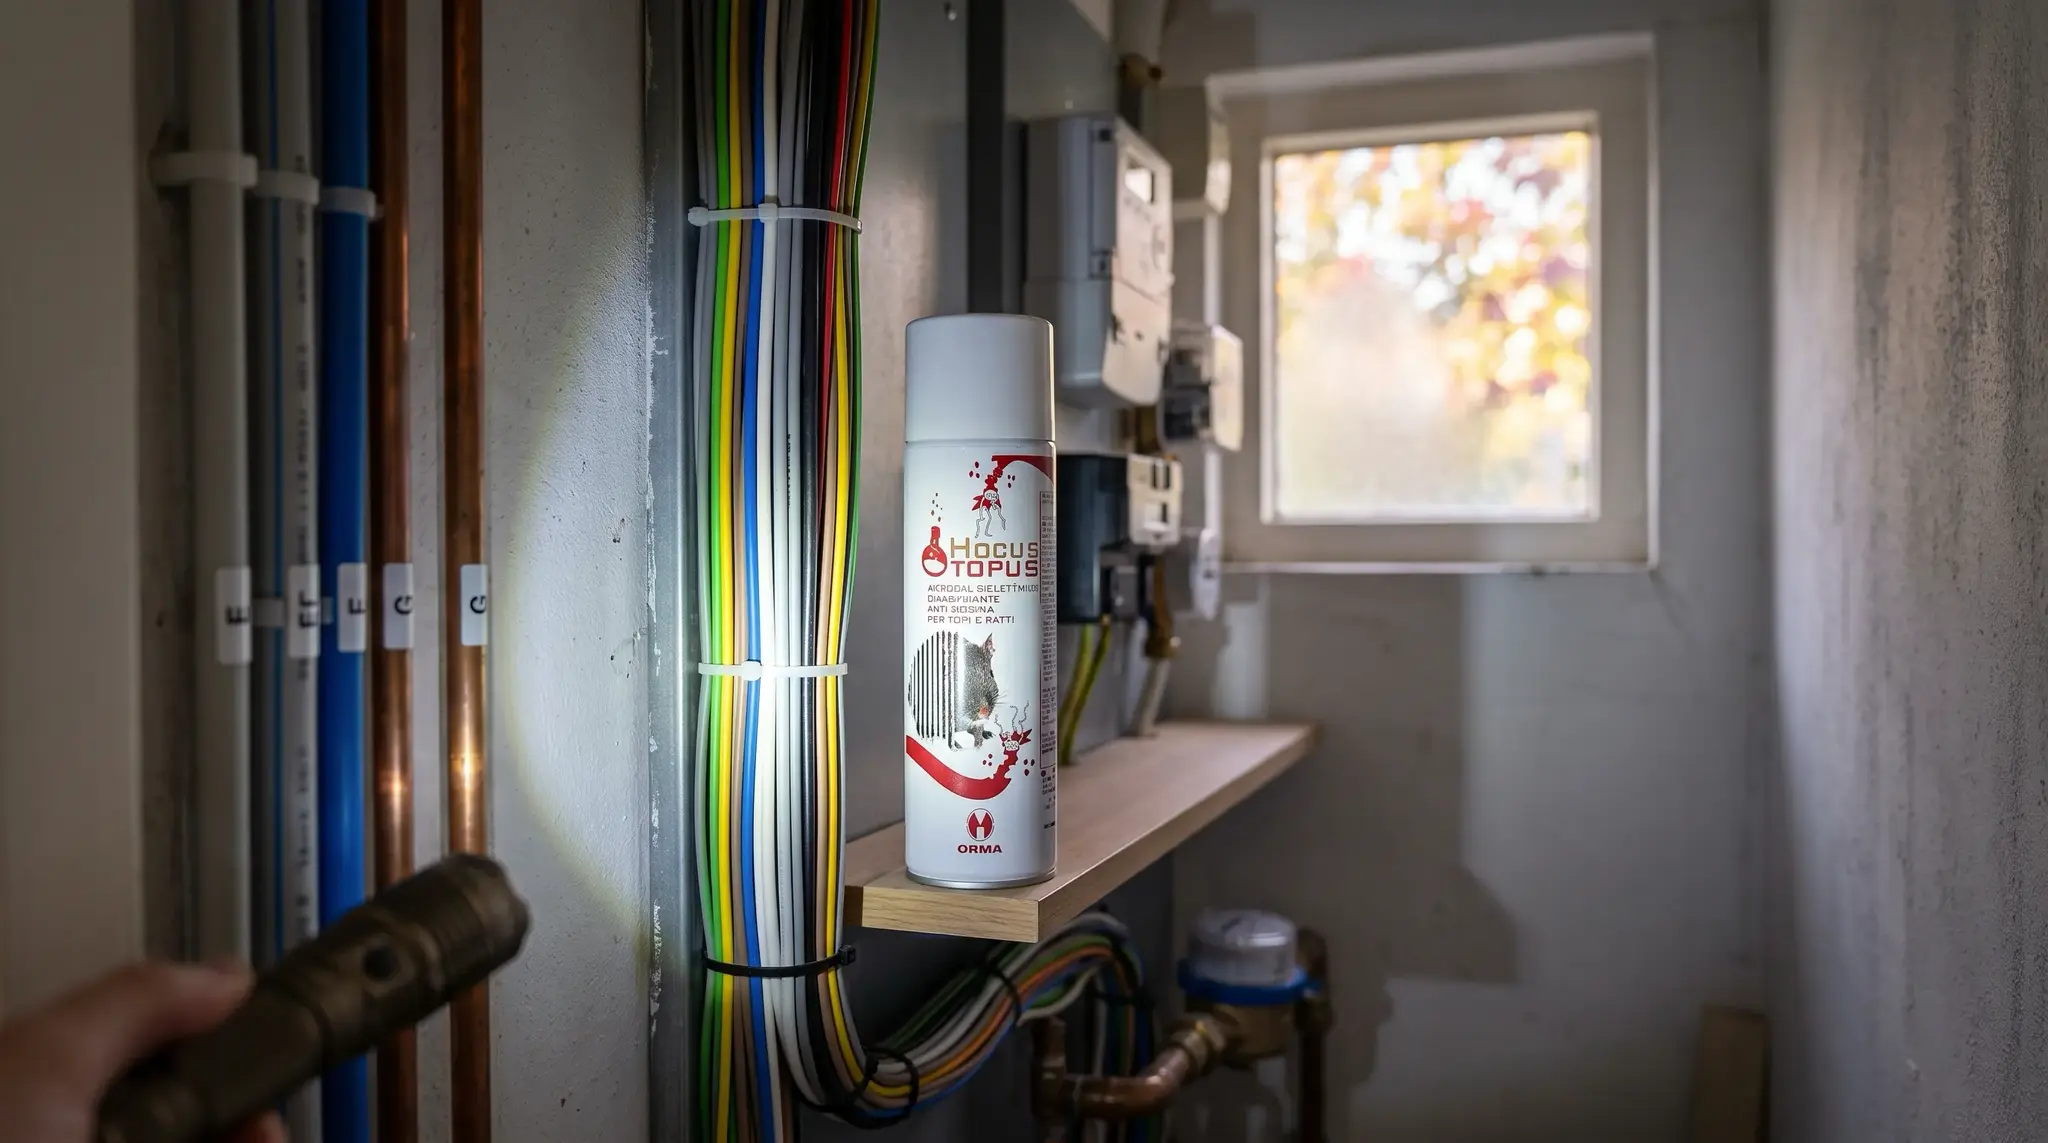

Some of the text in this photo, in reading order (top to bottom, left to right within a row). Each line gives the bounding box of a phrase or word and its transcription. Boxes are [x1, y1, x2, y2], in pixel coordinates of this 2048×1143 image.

[950, 537, 1039, 559] HOCUS
[950, 560, 1039, 578] TOPUS
[469, 595, 488, 614] G
[927, 605, 948, 614] ANTI
[927, 615, 1015, 624] PER TOPI E RATTI
[957, 844, 1003, 854] ORMA
